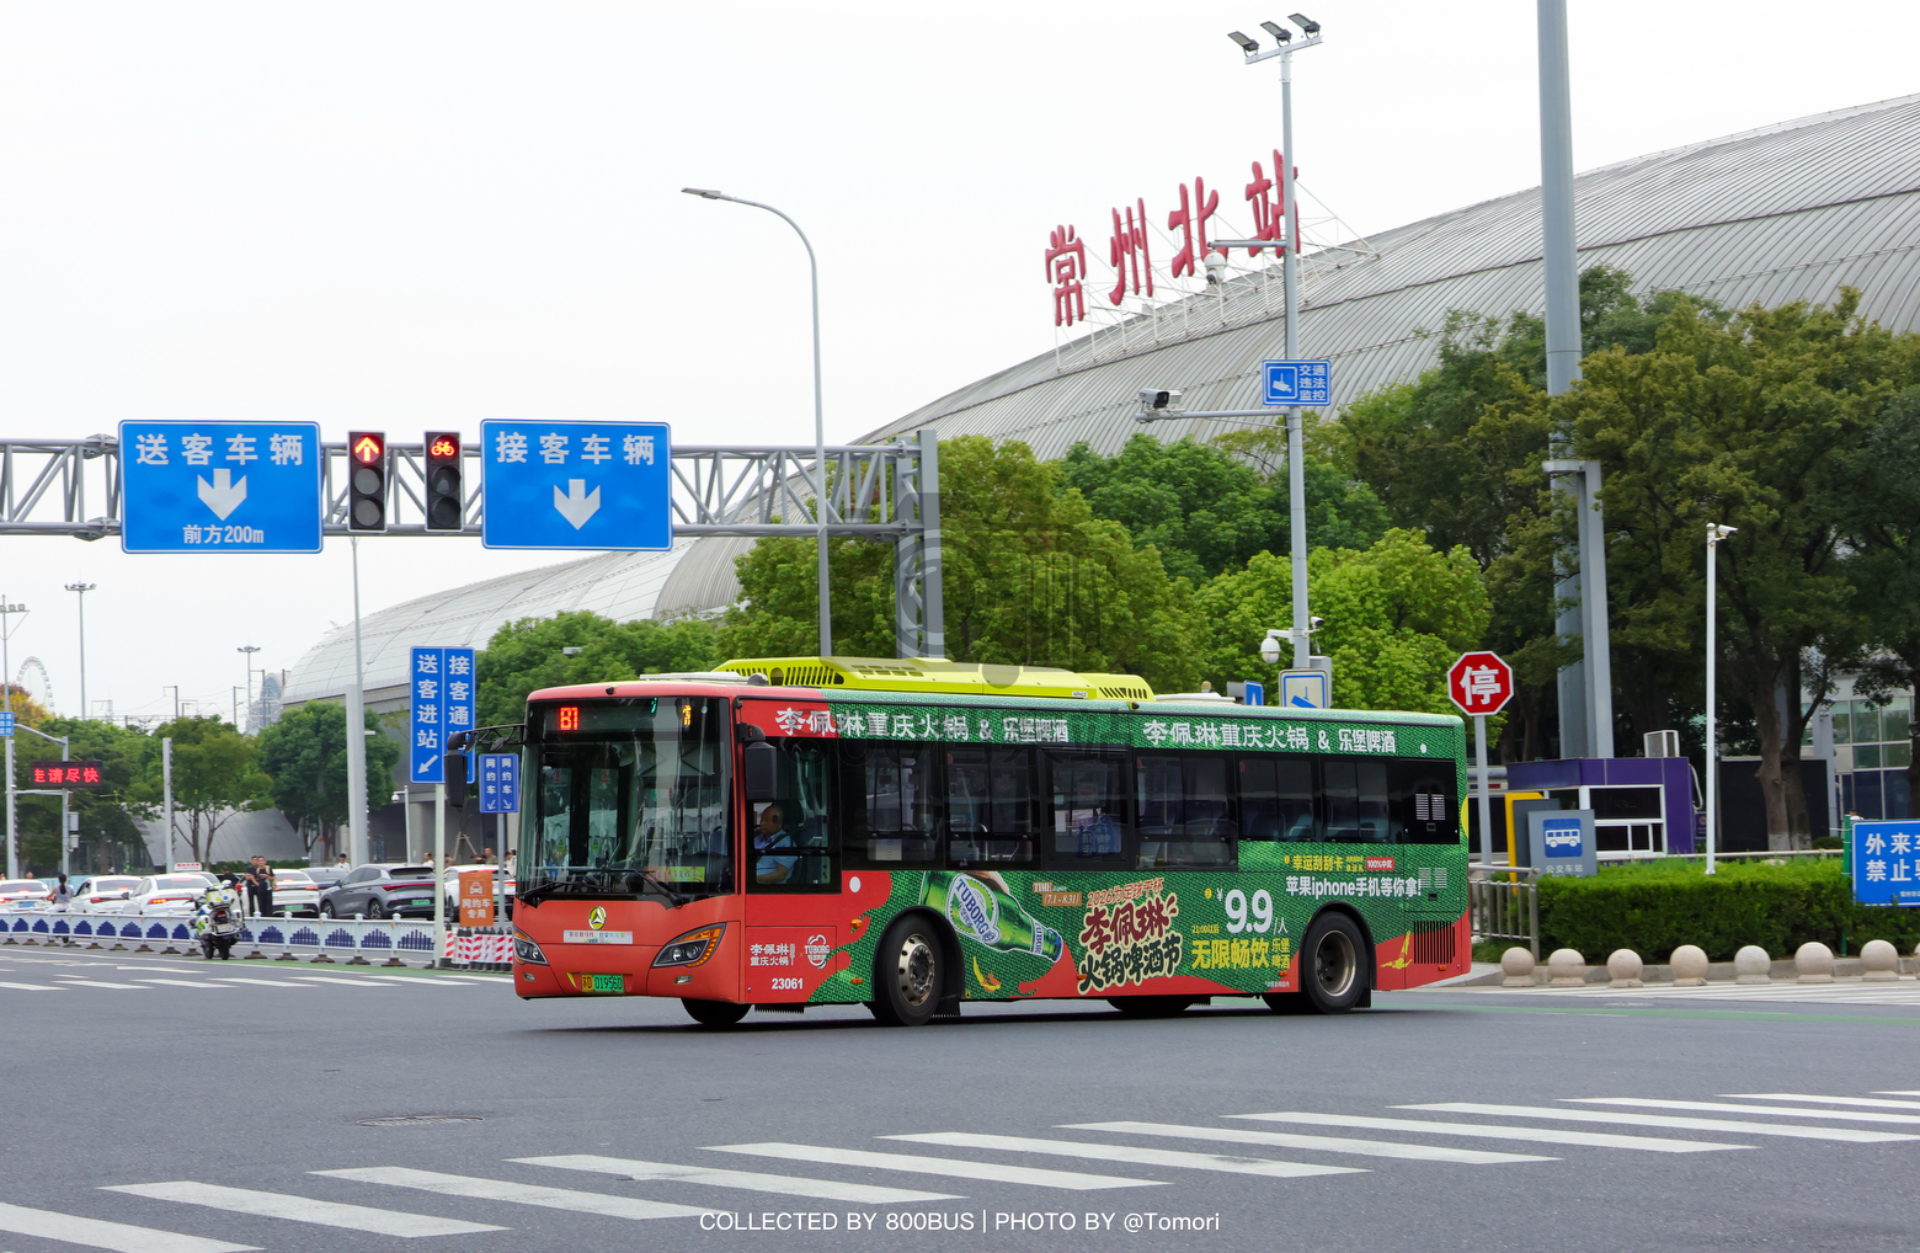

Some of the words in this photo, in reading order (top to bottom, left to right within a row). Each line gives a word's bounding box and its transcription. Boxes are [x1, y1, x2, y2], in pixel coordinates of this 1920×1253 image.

[1045, 149, 1300, 327] 常州北站
[1299, 365, 1326, 376] 交通
[1299, 377, 1326, 389] 违法
[1299, 389, 1326, 401] 监控
[135, 433, 303, 466] 送客车辆
[495, 431, 655, 466] 接客车辆
[182, 524, 265, 545] 前方200m
[416, 654, 439, 749] 送客进站
[1459, 664, 1502, 706] 停
[448, 655, 470, 751] 接客通
[774, 706, 969, 742] 李佩琳重庆火锅
[979, 717, 994, 740] &
[1003, 716, 1070, 743] 乐堡啤酒
[1142, 719, 1310, 750] 李佩琳重庆火锅
[1317, 730, 1331, 750] &
[1338, 728, 1397, 753] 乐堡啤酒
[485, 757, 497, 795] 网约车
[501, 757, 512, 795] 网约车
[1292, 854, 1344, 872] 幸运刮刮卡
[1081, 895, 1171, 955] 李佩琳
[750, 956, 789, 967] 重庆火锅
[1191, 937, 1270, 970] 无限畅饮
[1272, 937, 1290, 953] 乐堡
[1272, 954, 1290, 969] 啤酒
[1079, 933, 1181, 993] 火锅啤酒节
[771, 978, 803, 990] 23061
